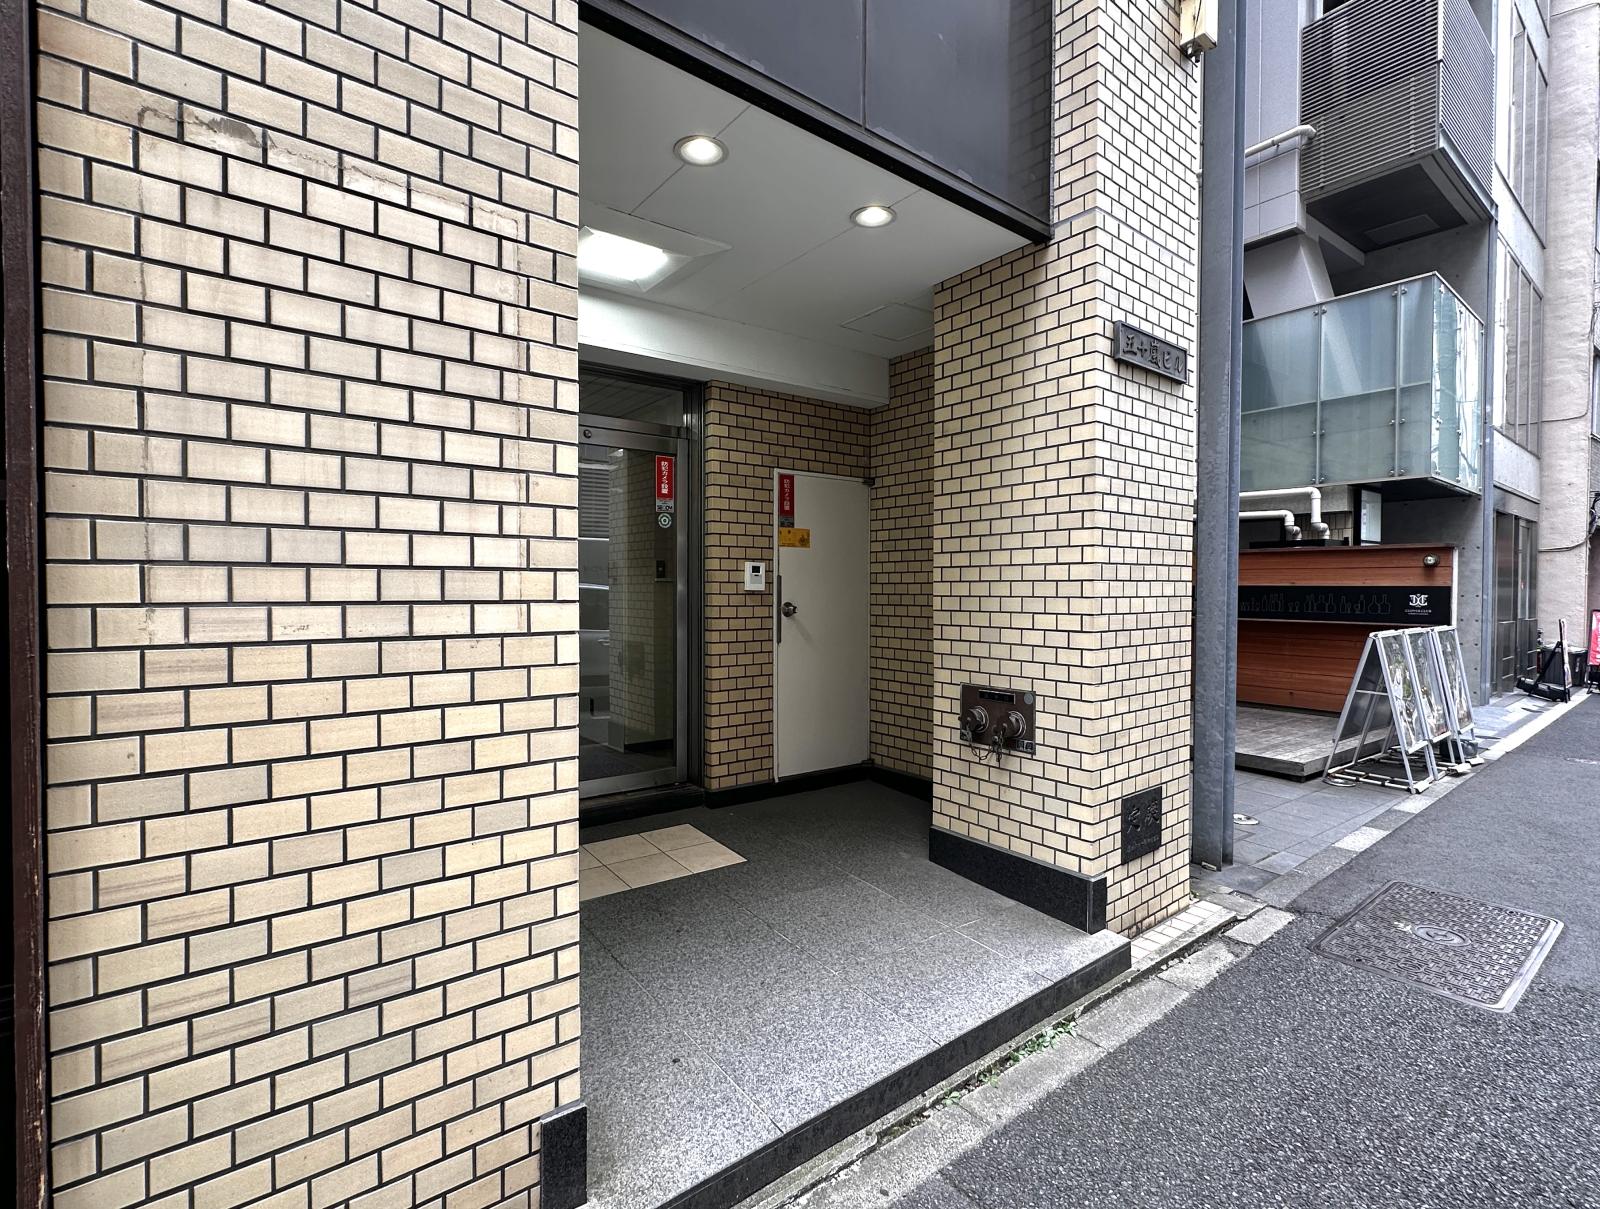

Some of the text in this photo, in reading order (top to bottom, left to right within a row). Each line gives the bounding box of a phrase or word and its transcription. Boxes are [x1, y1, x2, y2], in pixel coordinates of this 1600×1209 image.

[1122, 334, 1184, 374] 五十嵐ビル
[661, 461, 669, 494] 防犯カメラ設置
